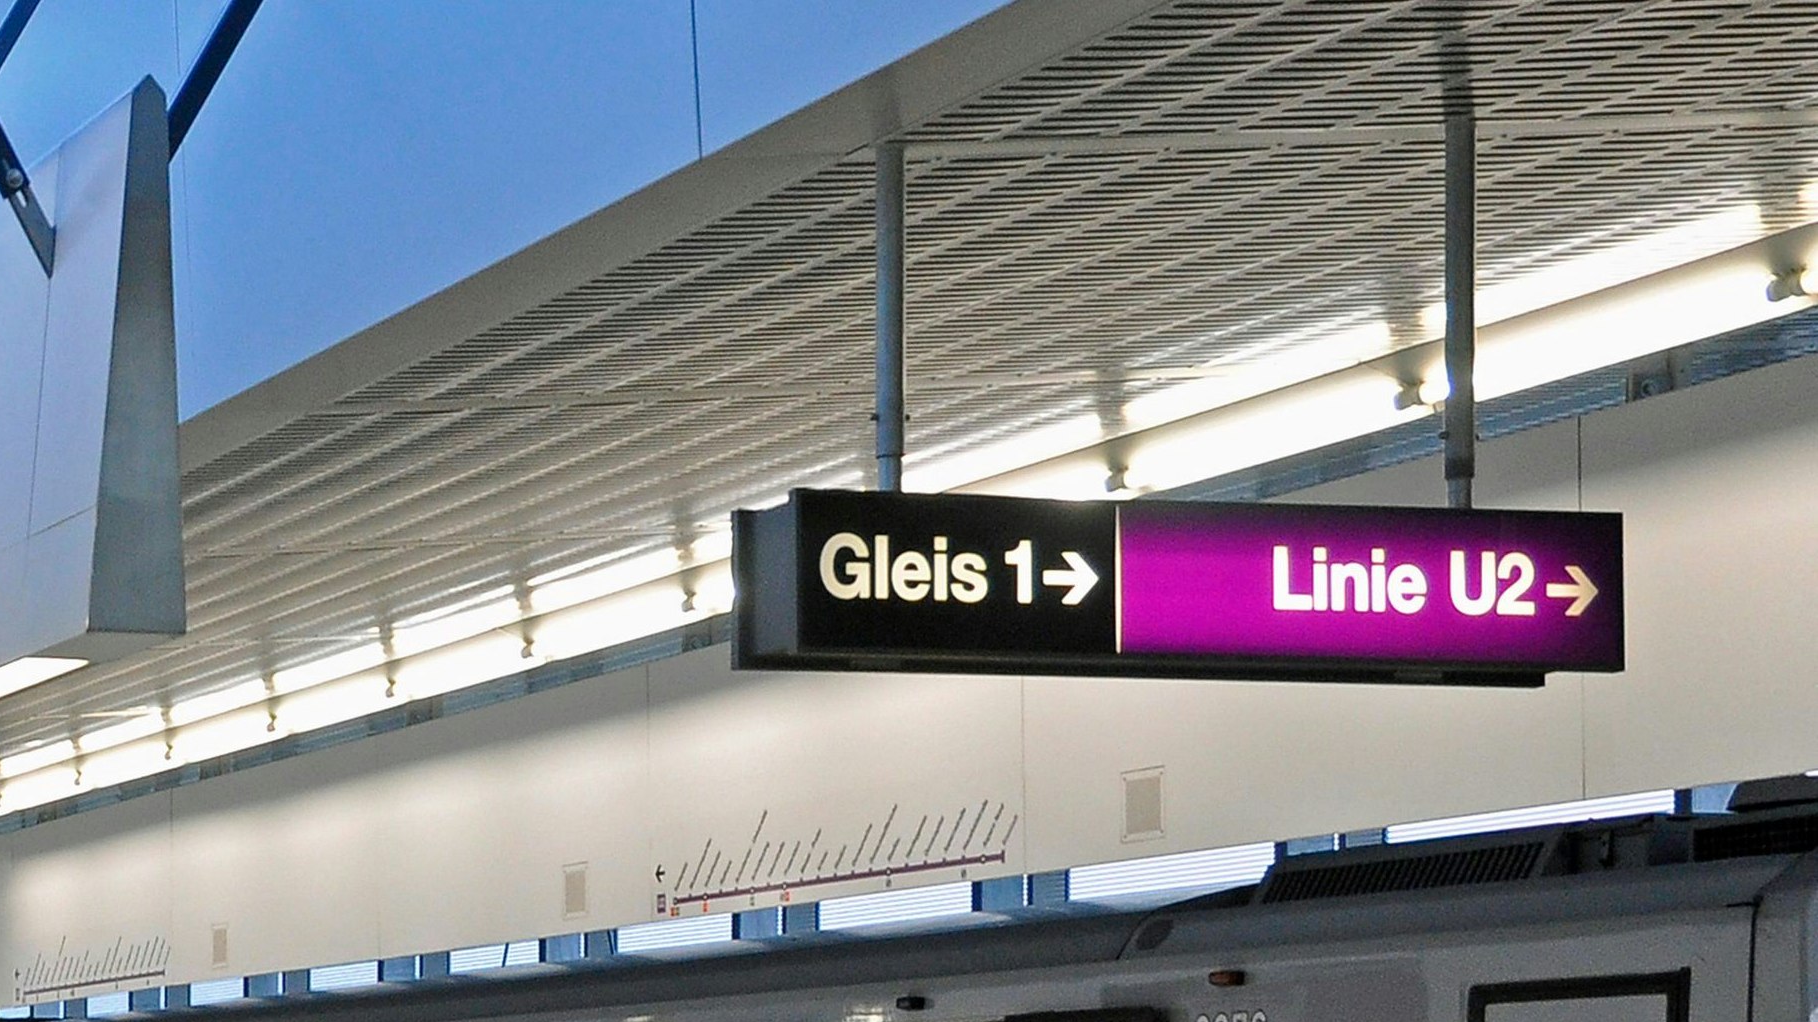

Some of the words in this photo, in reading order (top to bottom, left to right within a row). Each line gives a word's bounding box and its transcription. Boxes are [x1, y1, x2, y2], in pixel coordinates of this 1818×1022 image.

[819, 532, 989, 604] Gleis
[1004, 539, 1033, 605] 1
[1272, 545, 1428, 615] Linie
[1449, 550, 1536, 616] U2
